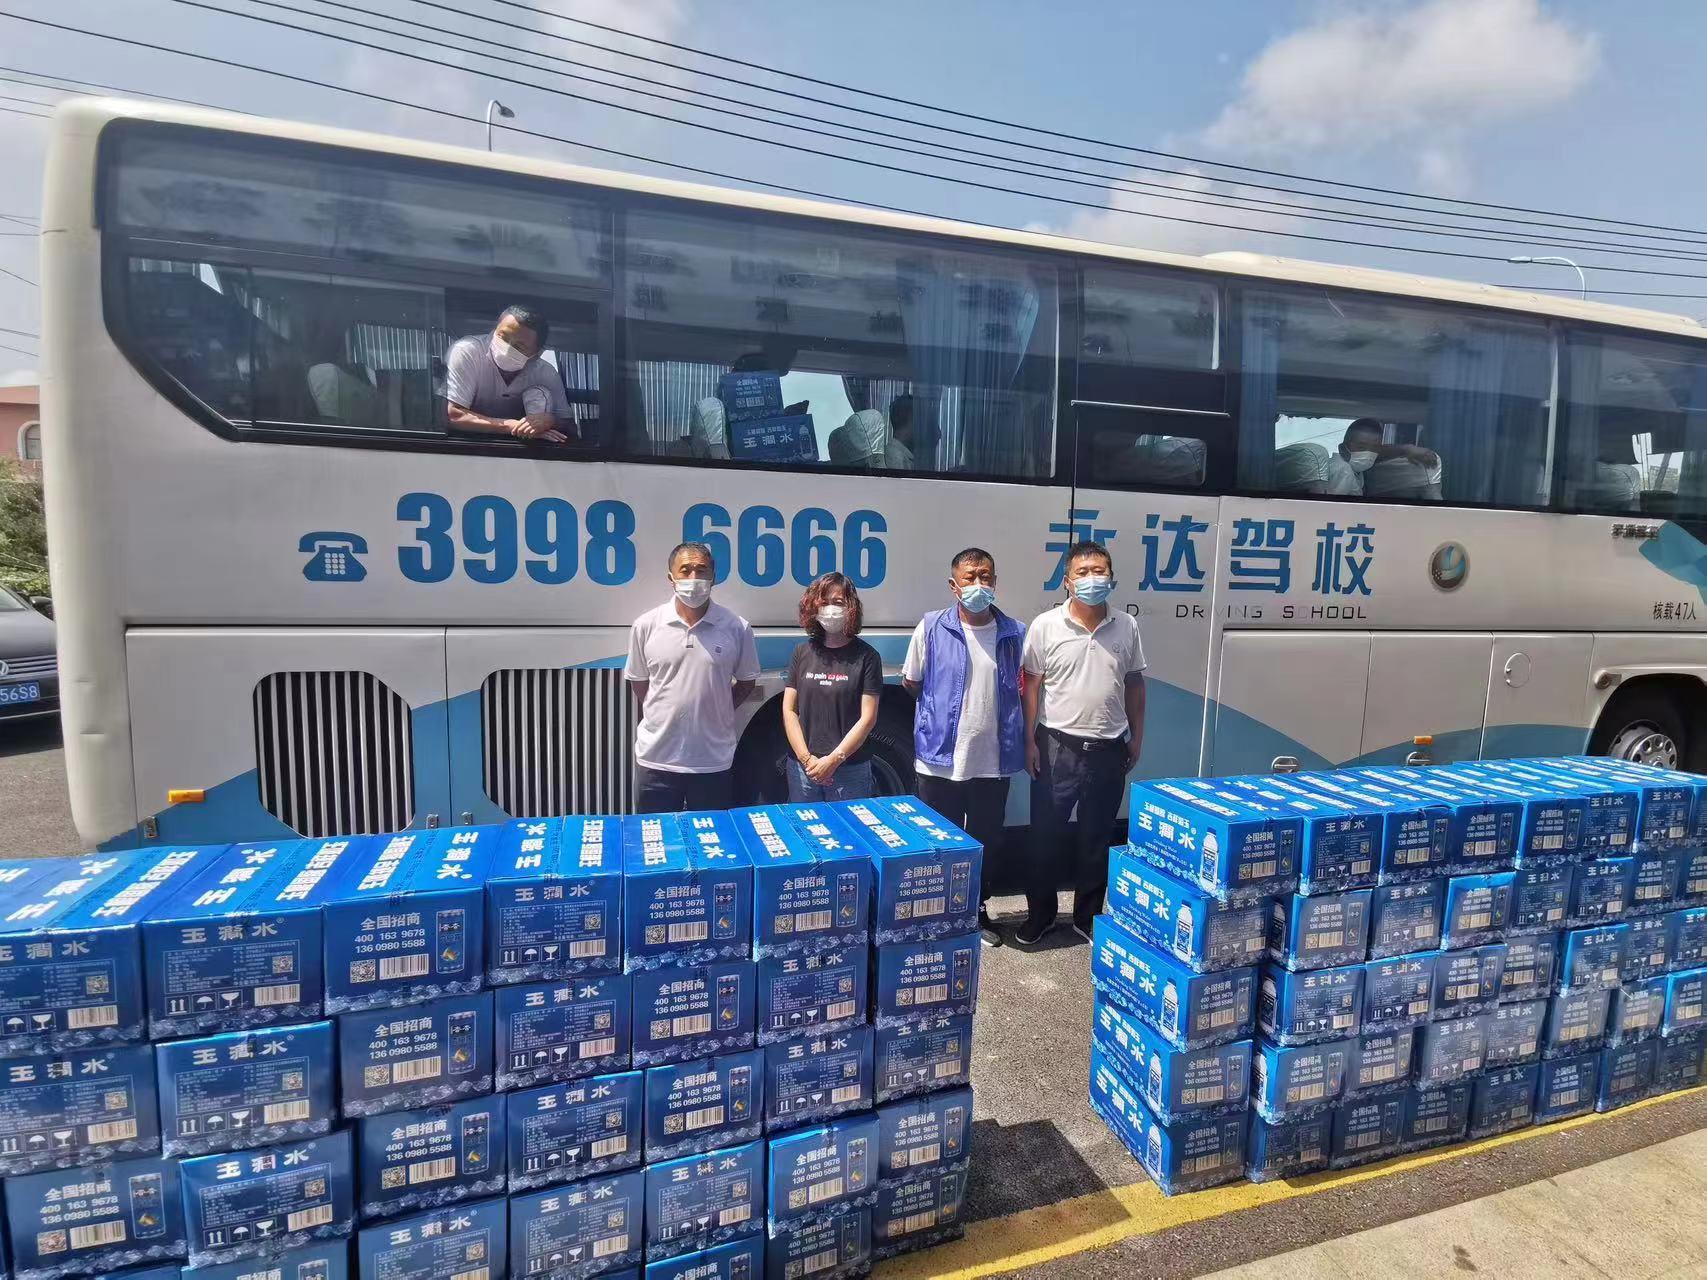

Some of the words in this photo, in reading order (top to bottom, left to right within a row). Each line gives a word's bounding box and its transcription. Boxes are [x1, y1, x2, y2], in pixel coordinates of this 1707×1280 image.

[396, 492, 636, 586] 3998
[682, 503, 888, 589] 6666
[1044, 508, 1376, 596] 永达驾校
[1653, 601, 1697, 620] 核载47人
[903, 865, 942, 878] 全国招商
[783, 876, 826, 890] 全国招商
[654, 885, 701, 899] 全国招商
[779, 893, 792, 901] 400
[812, 889, 829, 897] 9678
[686, 899, 704, 907] 9678
[779, 902, 792, 910] 136
[793, 900, 810, 908] 0980
[812, 898, 829, 906] 5588
[361, 912, 420, 931] 全国招商
[650, 911, 664, 919] 136
[666, 909, 684, 917] 0980
[686, 908, 704, 916] 5588
[355, 934, 373, 943] 400
[380, 932, 397, 940] 163
[402, 929, 425, 938] 9678
[355, 945, 373, 953] 136
[376, 942, 399, 951] 0980
[402, 939, 425, 948] 5588
[904, 952, 943, 966] 全国招商
[659, 979, 704, 995] 全国招商
[690, 992, 708, 1000] 9678
[670, 1003, 688, 1012] 0980
[690, 1001, 709, 1009] 5588
[375, 1017, 432, 1038] 全国招商
[369, 1040, 387, 1049] 400
[393, 1037, 410, 1045] 163
[414, 1033, 437, 1042] 9678
[370, 1051, 387, 1059] 136
[389, 1047, 412, 1056] 0980
[414, 1042, 437, 1052] 5588
[672, 1072, 717, 1090] 全国招商
[668, 1092, 682, 1100] 400
[703, 1085, 721, 1093] 9678
[668, 1101, 682, 1109] 136
[683, 1097, 701, 1106] 0980
[703, 1093, 721, 1102] 5588
[898, 1112, 935, 1129] 全国招商
[391, 1119, 447, 1140] 全国招商
[386, 1143, 403, 1152] 400
[409, 1139, 425, 1147] 163
[429, 1135, 452, 1144] 9678
[387, 1153, 403, 1162] 136
[405, 1148, 428, 1158] 0980
[430, 1144, 452, 1153] 5588
[796, 1146, 837, 1165] 全国招商
[44, 1180, 111, 1201] 全国招商
[896, 1180, 931, 1198] 全国招商
